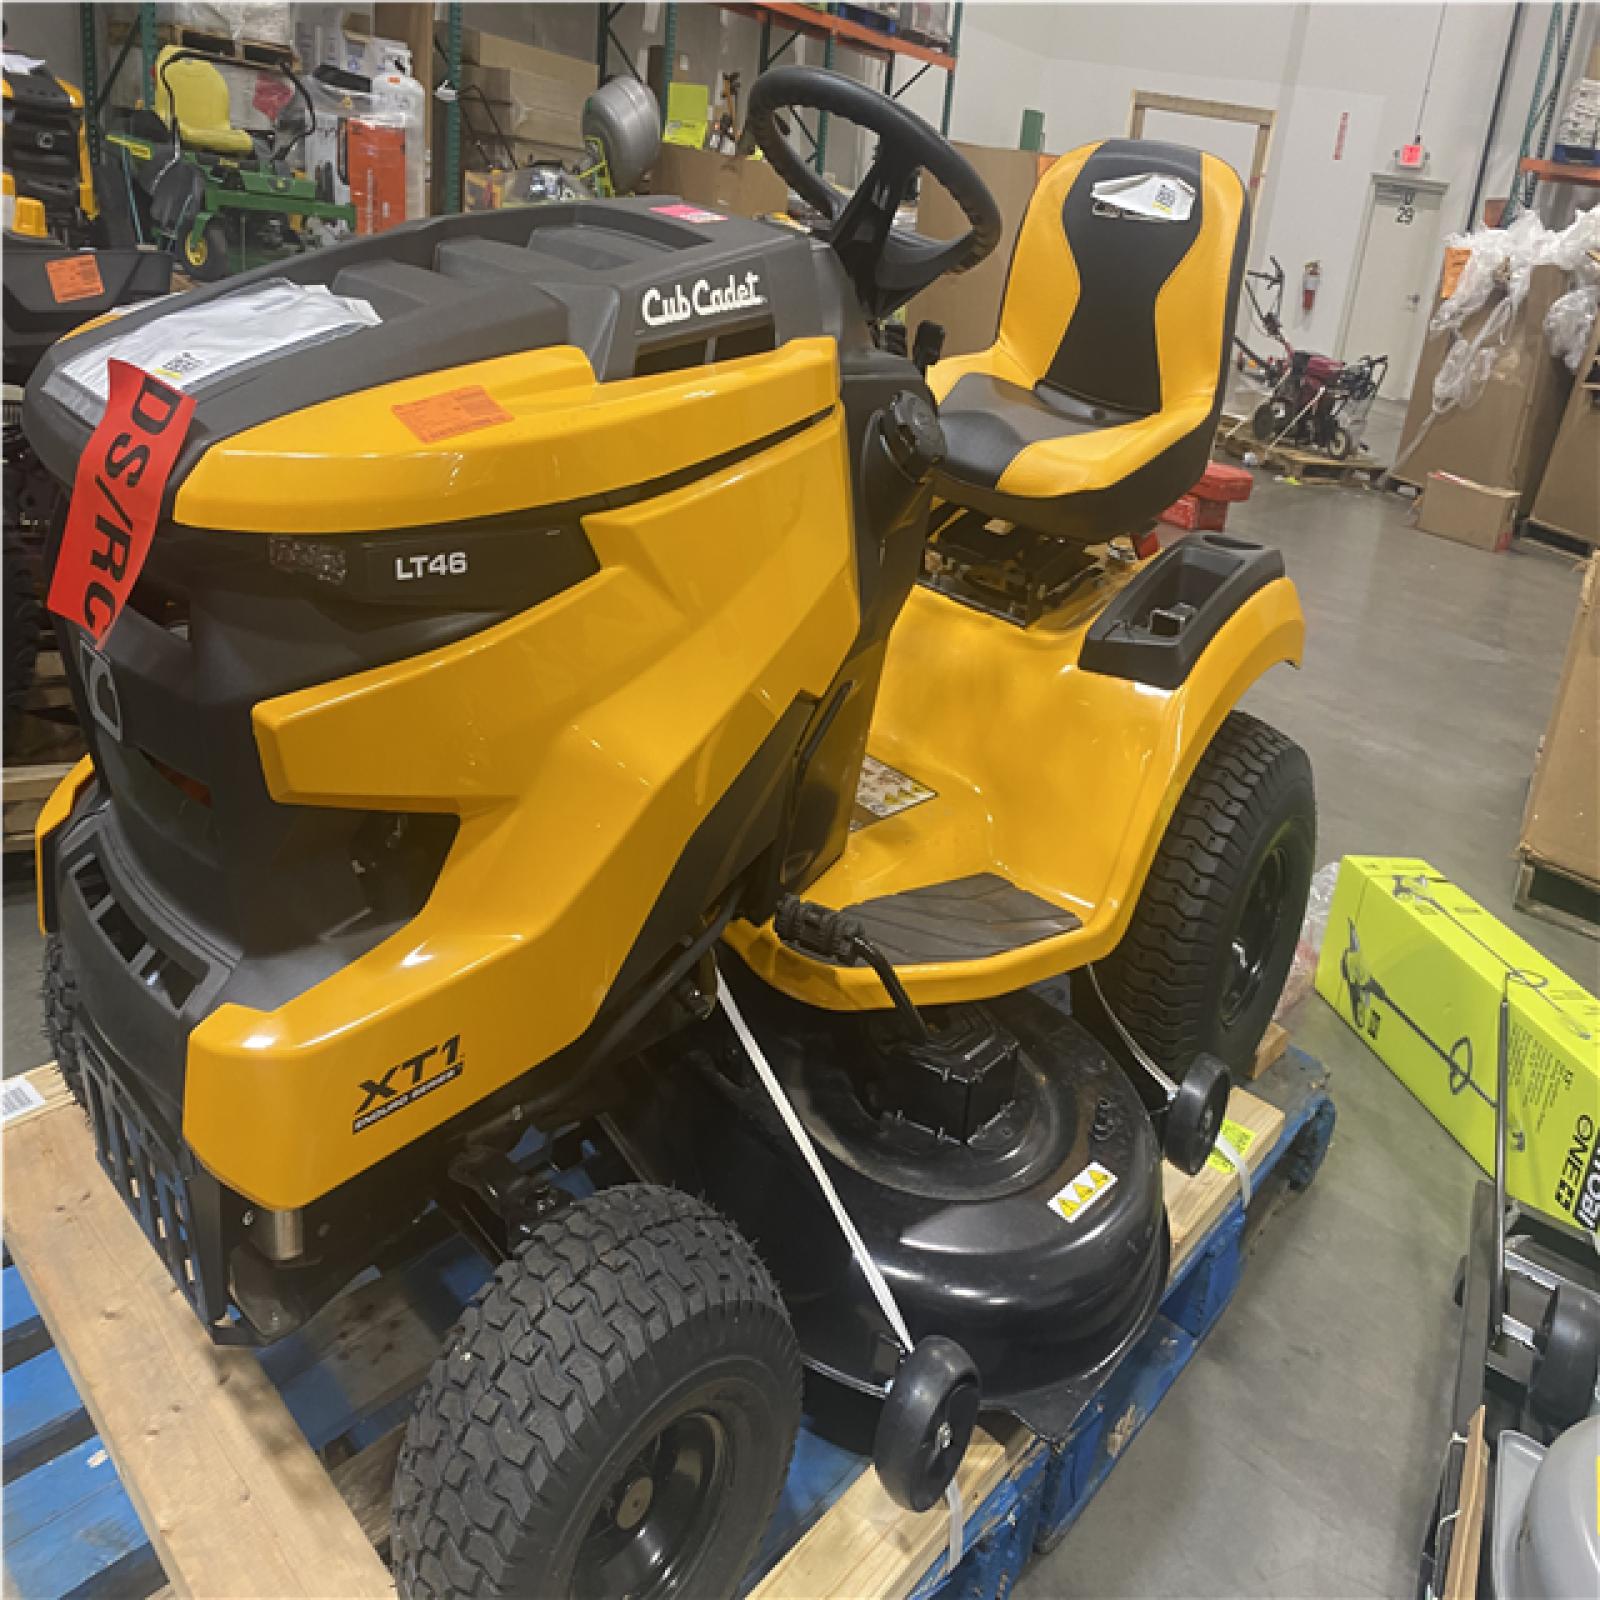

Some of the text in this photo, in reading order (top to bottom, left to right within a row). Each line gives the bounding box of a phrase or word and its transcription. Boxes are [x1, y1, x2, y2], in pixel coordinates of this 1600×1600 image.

[642, 271, 768, 326] Cub Cadet
[83, 375, 182, 634] DS/RC
[394, 552, 467, 581] LT46
[354, 1034, 461, 1116] XT1
